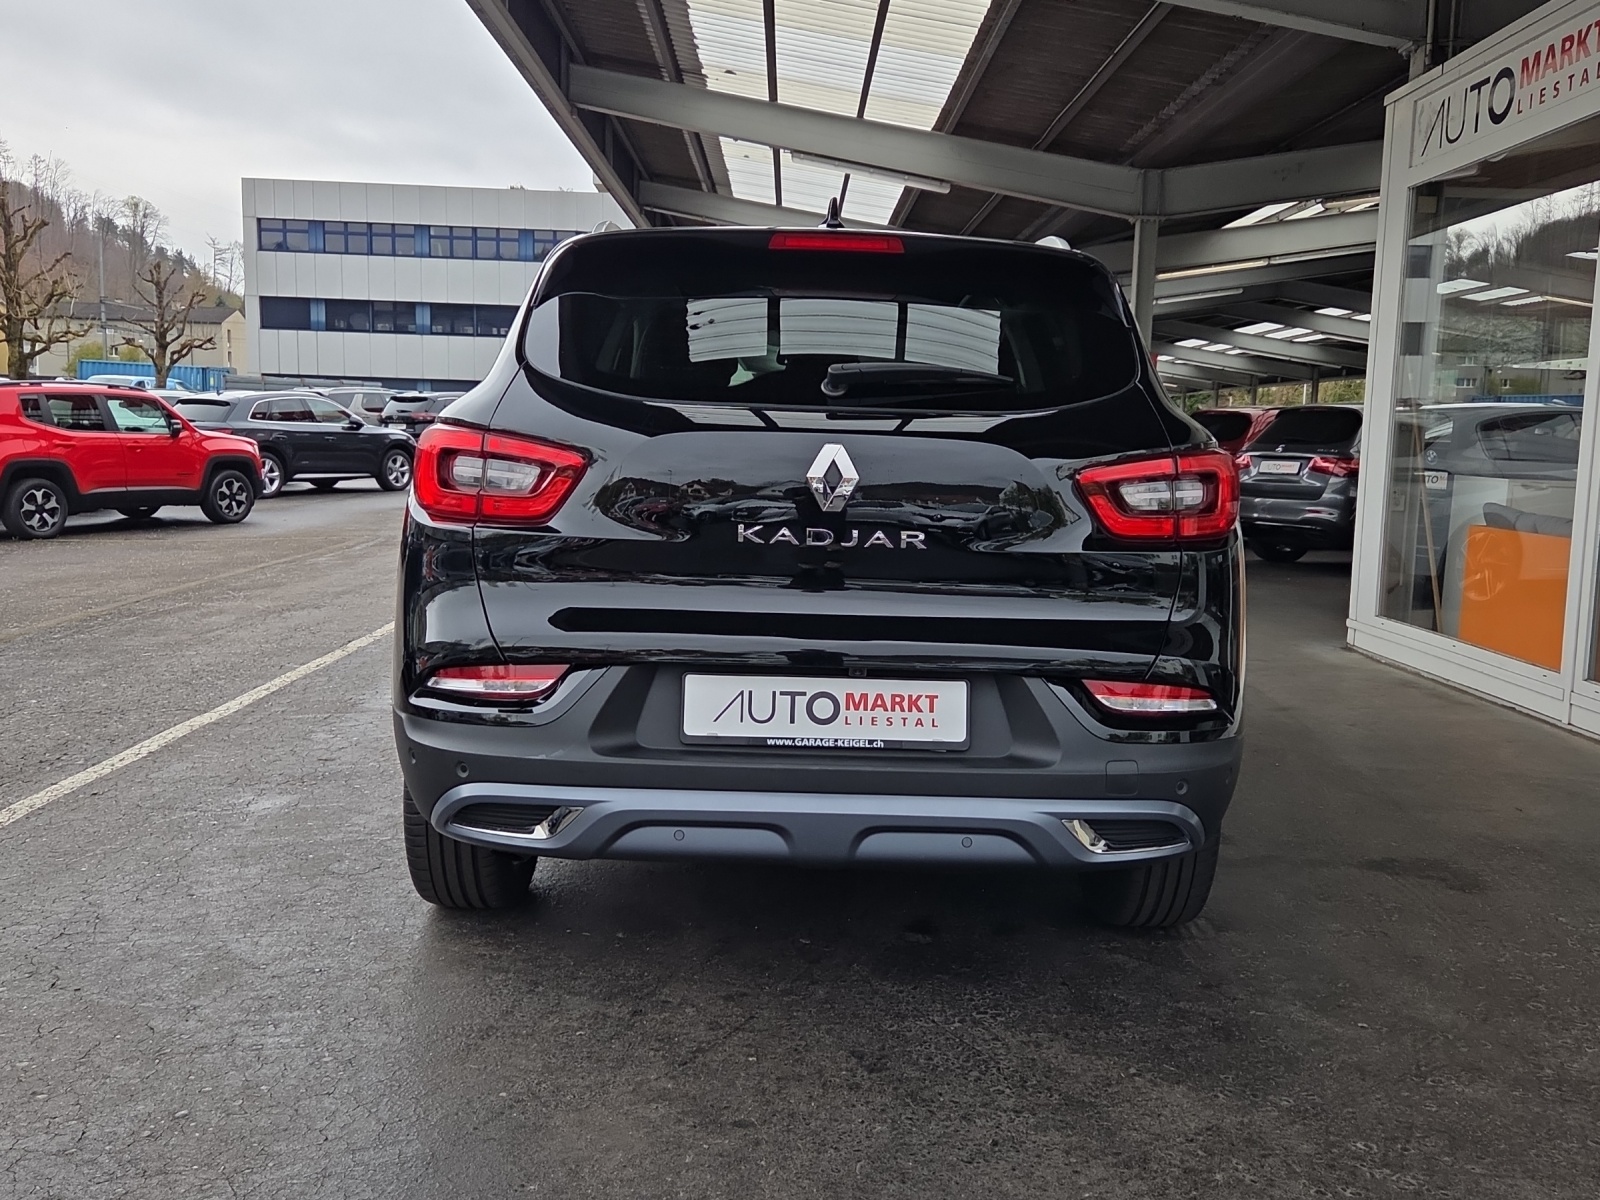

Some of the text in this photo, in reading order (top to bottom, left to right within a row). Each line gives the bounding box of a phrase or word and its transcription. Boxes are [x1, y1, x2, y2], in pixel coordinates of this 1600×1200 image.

[1421, 66, 1516, 157] AUTO
[737, 523, 927, 549] KADJAR
[713, 689, 939, 726] AUTO MARKT
[844, 716, 939, 728] LIESTAL
[766, 736, 884, 749] www.GARAGE-KEIGEL.ch
